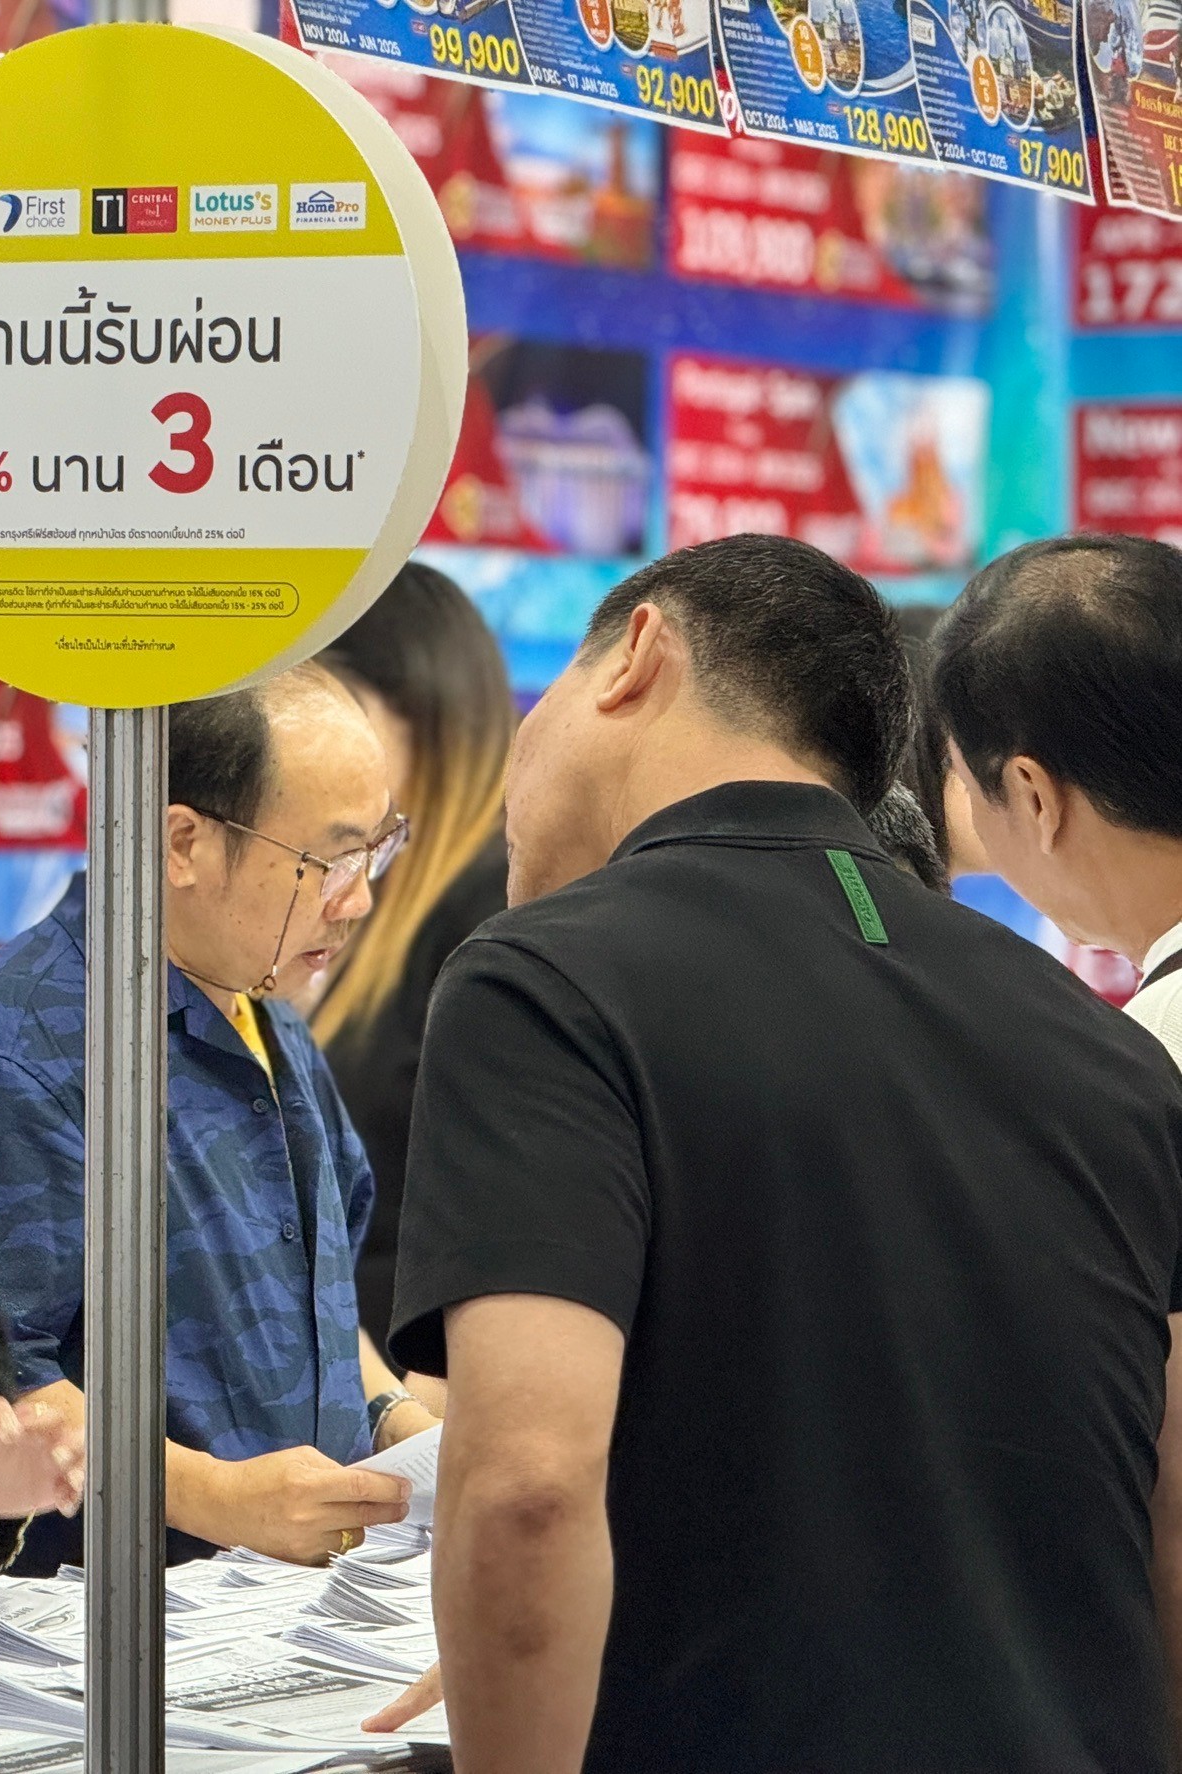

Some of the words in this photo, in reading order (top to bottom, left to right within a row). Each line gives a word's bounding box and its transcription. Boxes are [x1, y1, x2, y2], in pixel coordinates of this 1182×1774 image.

[302, 23, 323, 41] NOV
[325, 27, 350, 46] 2024
[359, 33, 377, 51] JUN
[377, 38, 401, 56] 2025
[430, 24, 520, 76] 99,900
[531, 65, 542, 81] 30
[545, 69, 561, 87] DEC
[568, 73, 579, 89] 07
[581, 75, 597, 93] JAN
[599, 80, 619, 99] 2025
[636, 65, 715, 118] 92,900
[745, 110, 764, 127] OCT
[767, 114, 788, 132] 2024
[795, 118, 816, 137] MAR
[817, 122, 839, 141] 2025
[843, 105, 928, 151] 128,900
[944, 143, 967, 161] 2024
[971, 148, 988, 167] OCT
[990, 152, 1008, 171] 2025
[1019, 139, 1084, 188] 87,900
[26, 196, 65, 215] First
[96, 195, 123, 227] T1
[131, 194, 173, 204] CENTRAL
[195, 191, 272, 212] Lotus's
[296, 201, 360, 214] HomePro
[26, 215, 65, 228] choice
[195, 217, 238, 226] MONEY
[241, 216, 272, 225] PLUS
[32, 454, 124, 493] นาน
[147, 392, 214, 494] 3
[205, 530, 224, 539] 25%
[227, 527, 245, 540] ต่อปี
